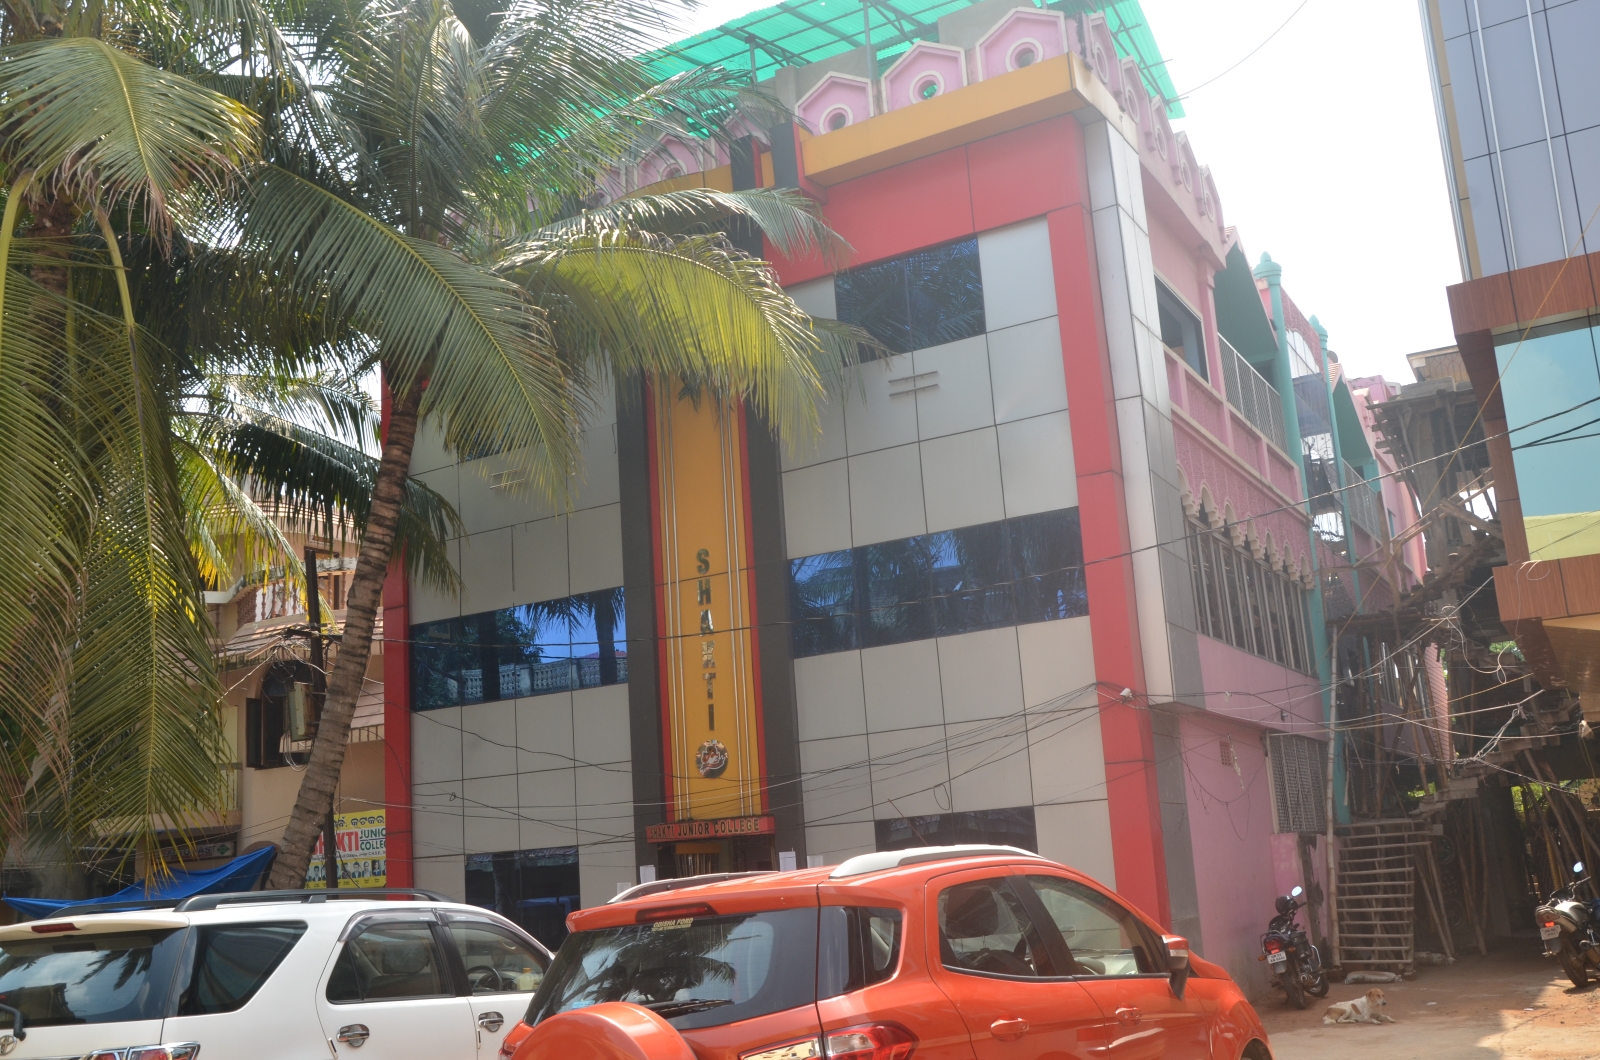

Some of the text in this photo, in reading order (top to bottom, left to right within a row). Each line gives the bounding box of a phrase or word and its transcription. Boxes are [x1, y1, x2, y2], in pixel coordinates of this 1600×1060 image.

[696, 548, 716, 731] SHAKTI
[650, 818, 760, 839] SHAKTI JUNIOR COLLEGE
[360, 840, 386, 851] COLLE
